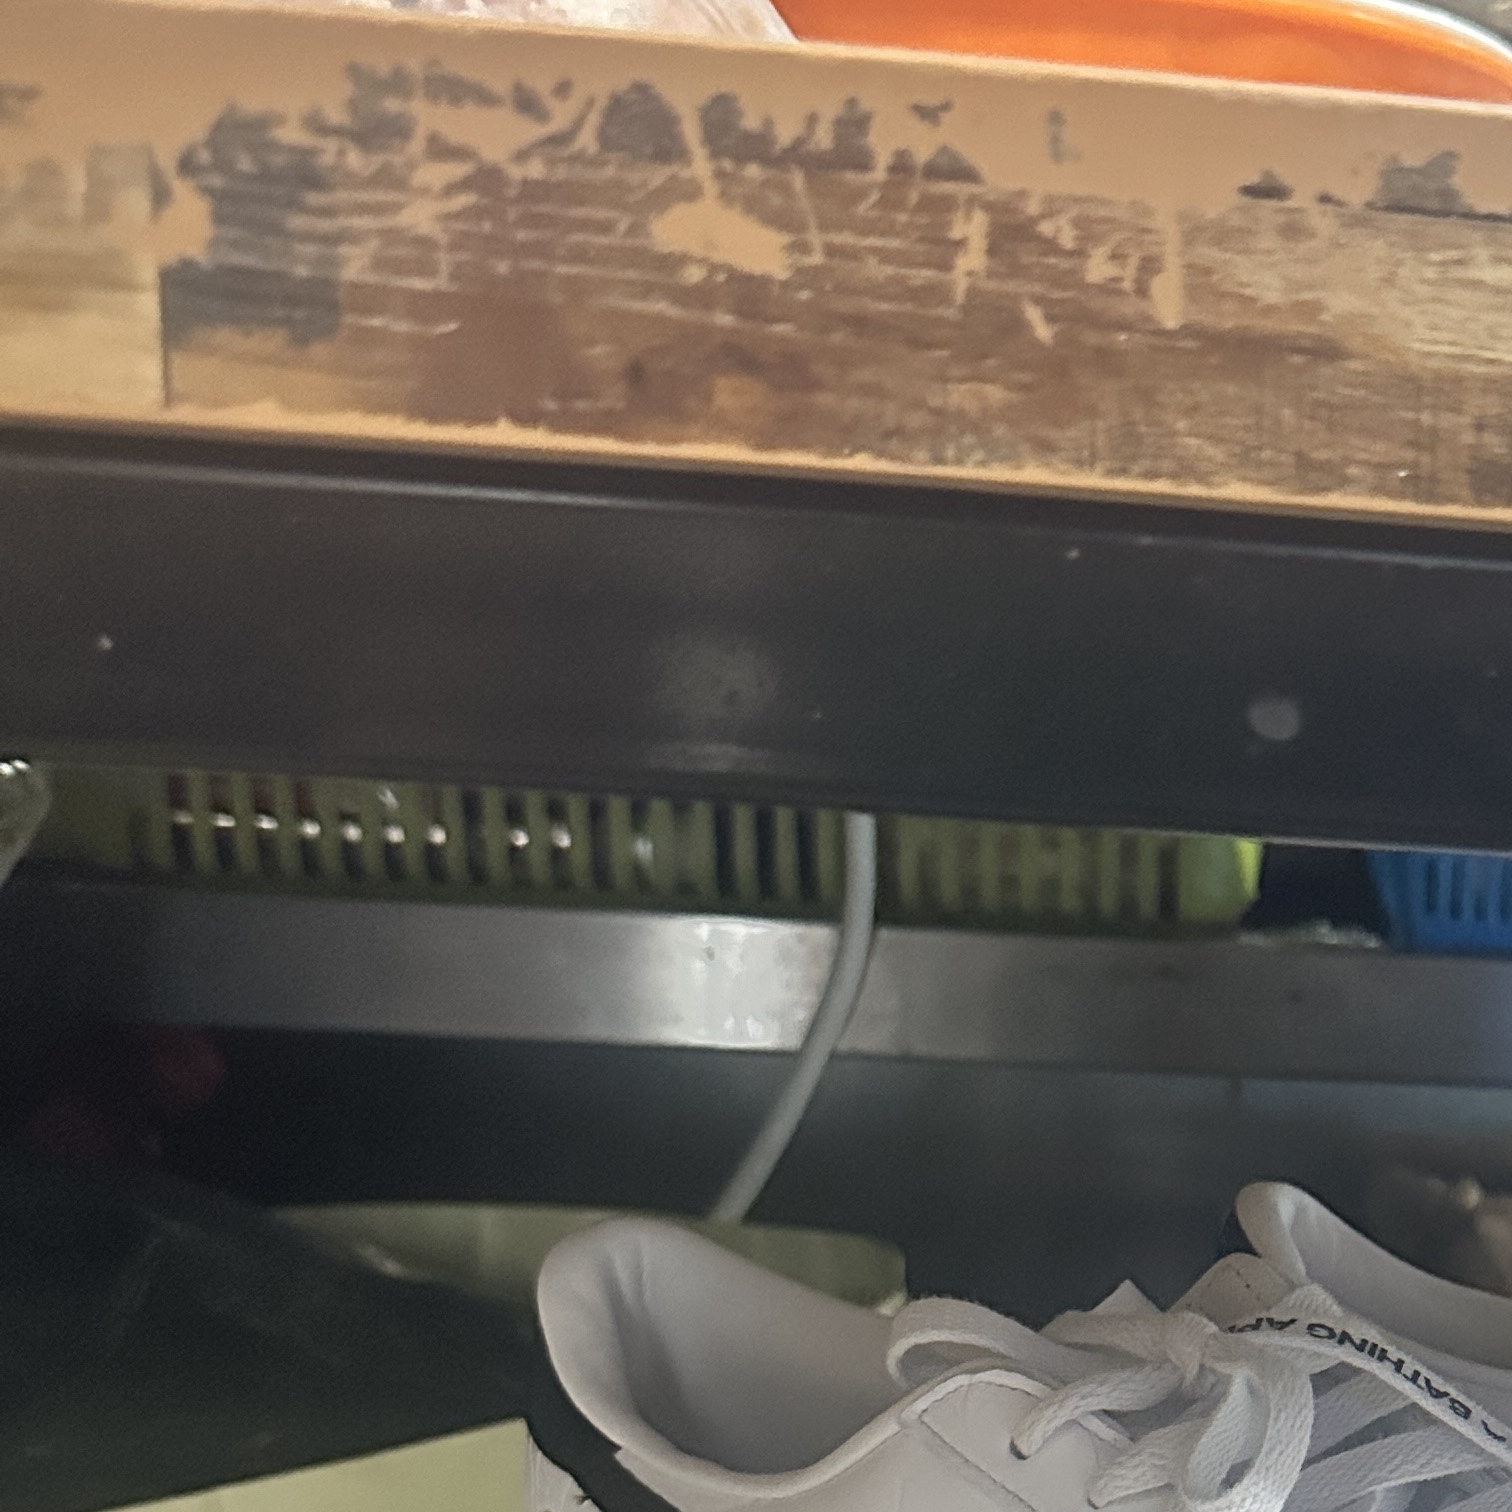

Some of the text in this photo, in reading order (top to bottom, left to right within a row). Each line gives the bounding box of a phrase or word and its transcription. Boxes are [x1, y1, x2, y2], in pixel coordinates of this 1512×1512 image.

[1226, 1317, 1507, 1443] A BATHING AP
